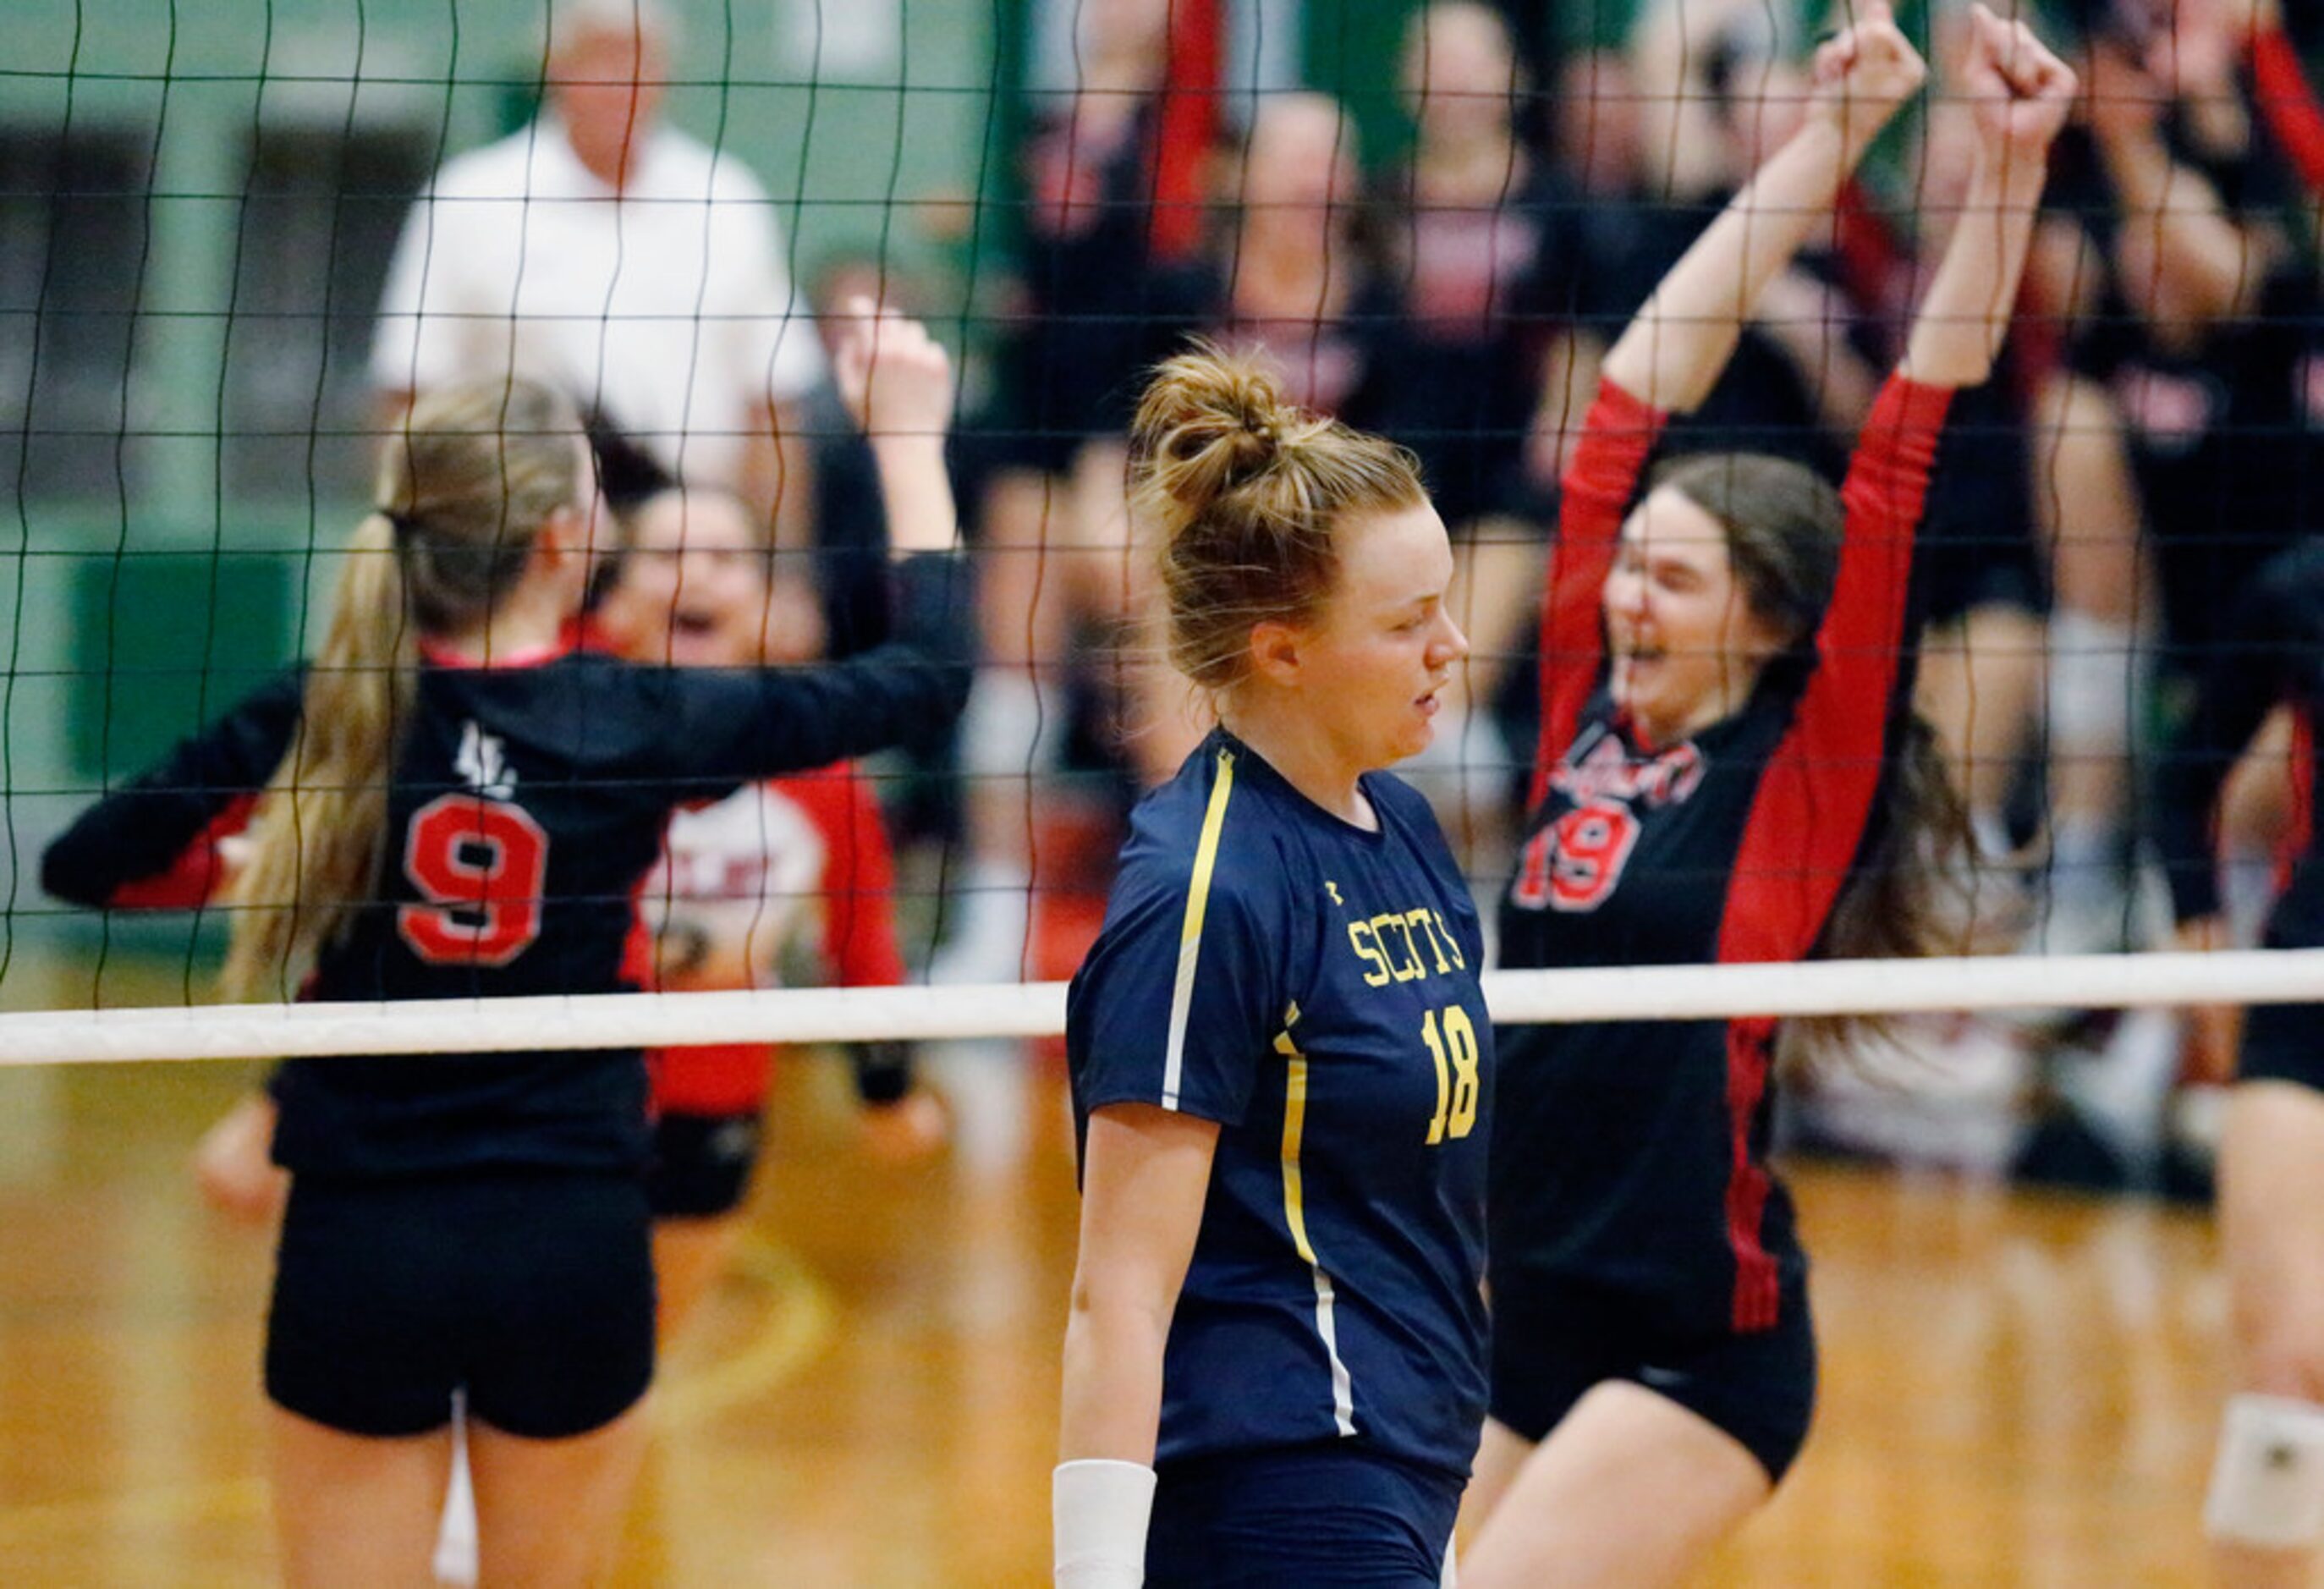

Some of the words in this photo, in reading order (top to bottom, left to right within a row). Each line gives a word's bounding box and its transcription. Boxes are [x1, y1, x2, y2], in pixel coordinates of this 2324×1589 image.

[398, 792, 549, 967] 9
[1511, 799, 1642, 913] 19
[1421, 1004, 1480, 1145] 18
